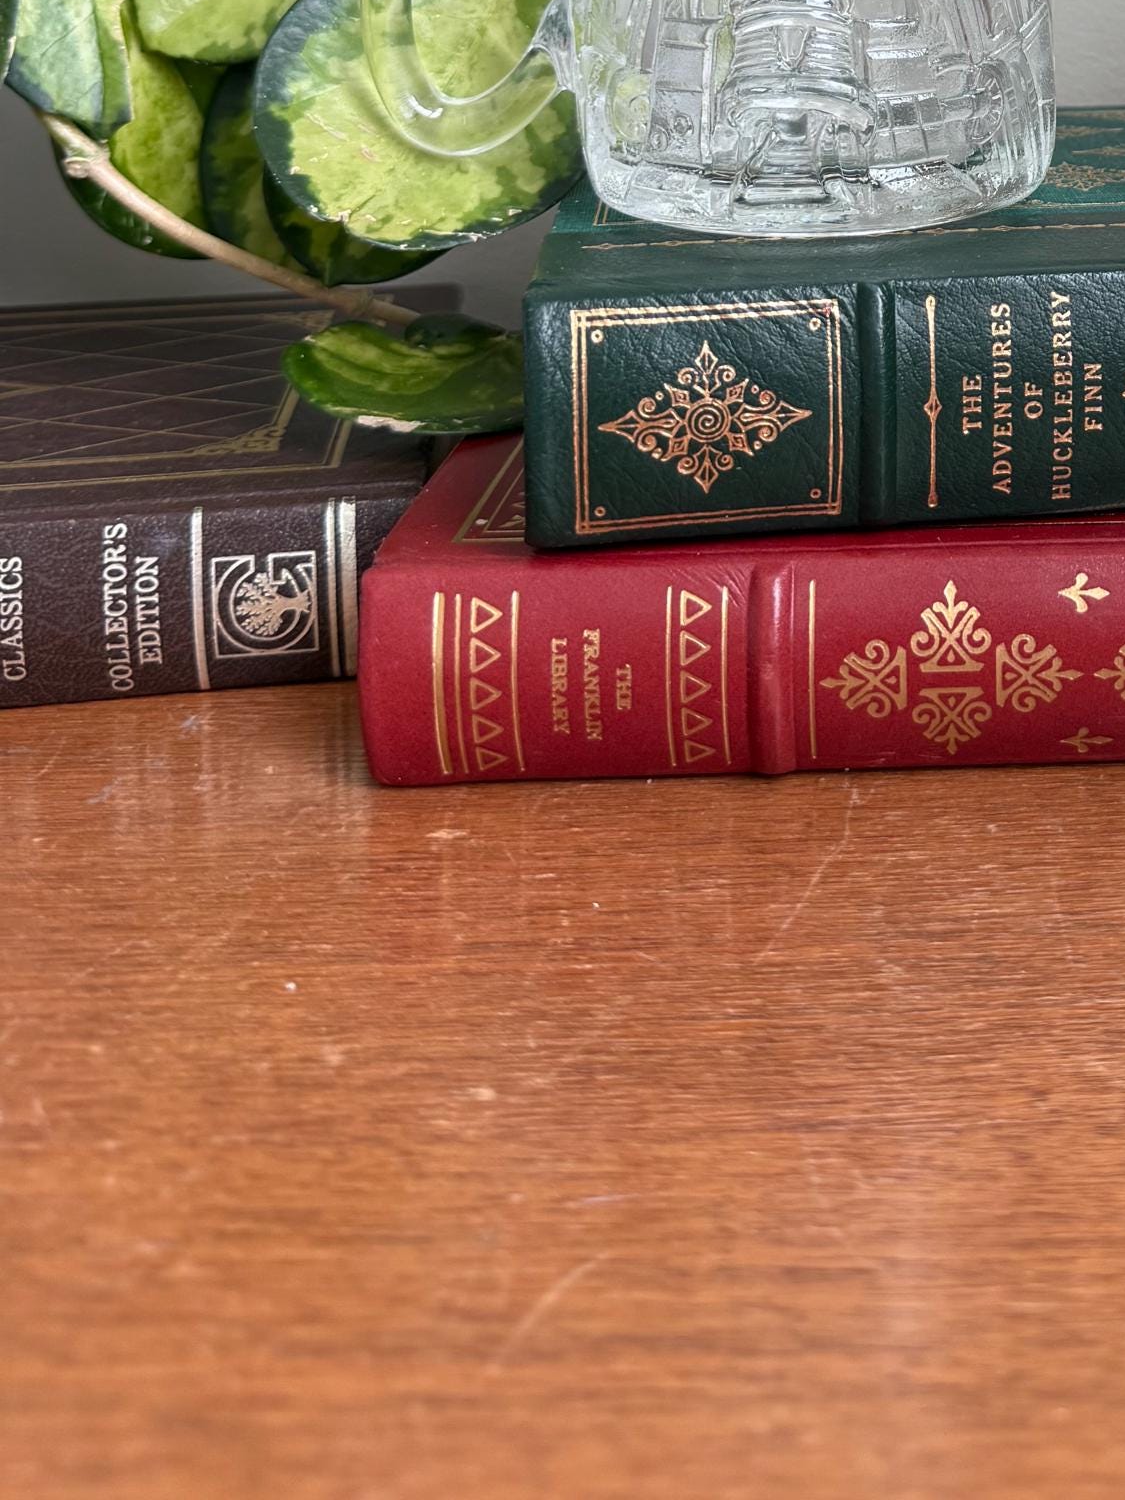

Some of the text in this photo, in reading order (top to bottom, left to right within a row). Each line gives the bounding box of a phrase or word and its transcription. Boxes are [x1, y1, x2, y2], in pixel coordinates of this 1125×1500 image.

[962, 374, 983, 434] THE
[991, 303, 1012, 494] ADVENTURES
[1023, 382, 1044, 419] OF
[1050, 291, 1073, 500] HUCKLEBERRY
[1083, 363, 1103, 431] FINN
[0, 556, 27, 681] CLASSICS
[103, 522, 134, 691] COLLECTOR'S
[135, 556, 162, 664] EDITION
[551, 638, 570, 734] LIBRARY
[583, 628, 602, 740] FRANKLIN
[616, 663, 632, 710] THE
